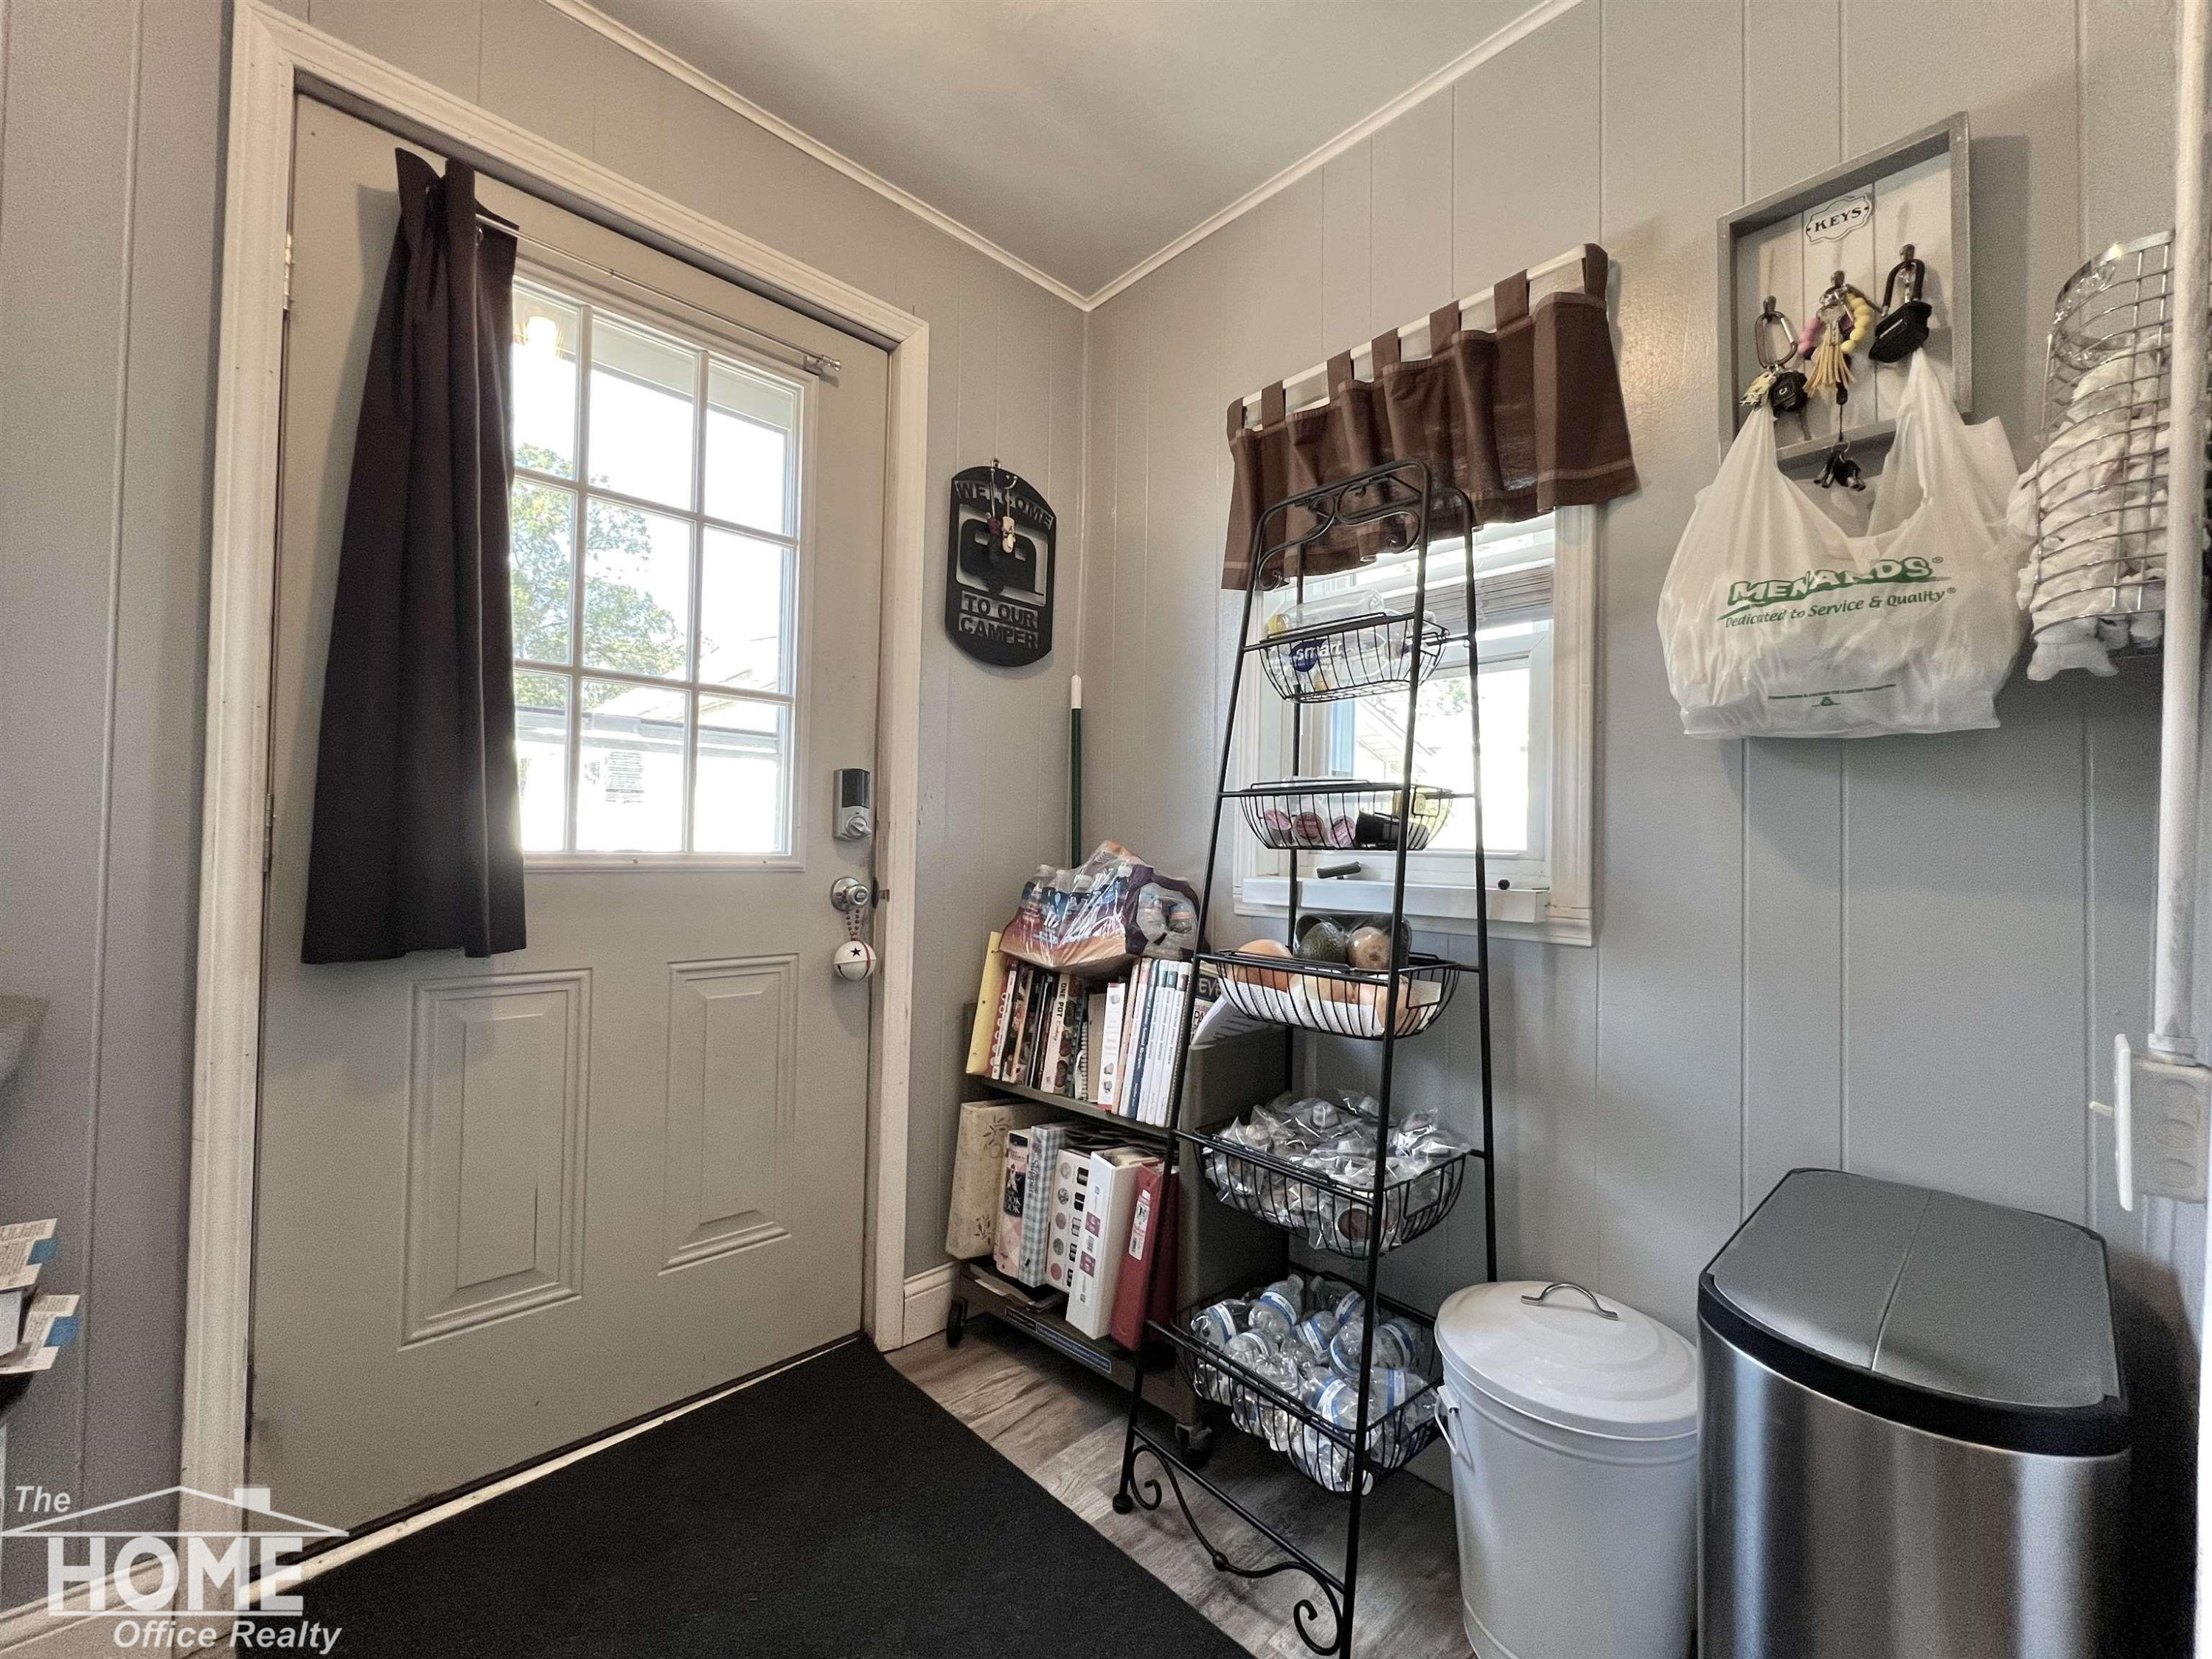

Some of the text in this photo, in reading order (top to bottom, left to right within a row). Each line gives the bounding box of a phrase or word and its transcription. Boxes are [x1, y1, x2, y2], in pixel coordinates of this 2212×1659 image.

[1815, 207, 1861, 232] KEYS
[963, 594, 1037, 629] TO OUR
[1725, 590, 1945, 628] Dedicated to Service & Quality
[960, 616, 1039, 650] CAMPER
[1060, 982, 1068, 999] ONE
[1056, 1001, 1064, 1018] POT
